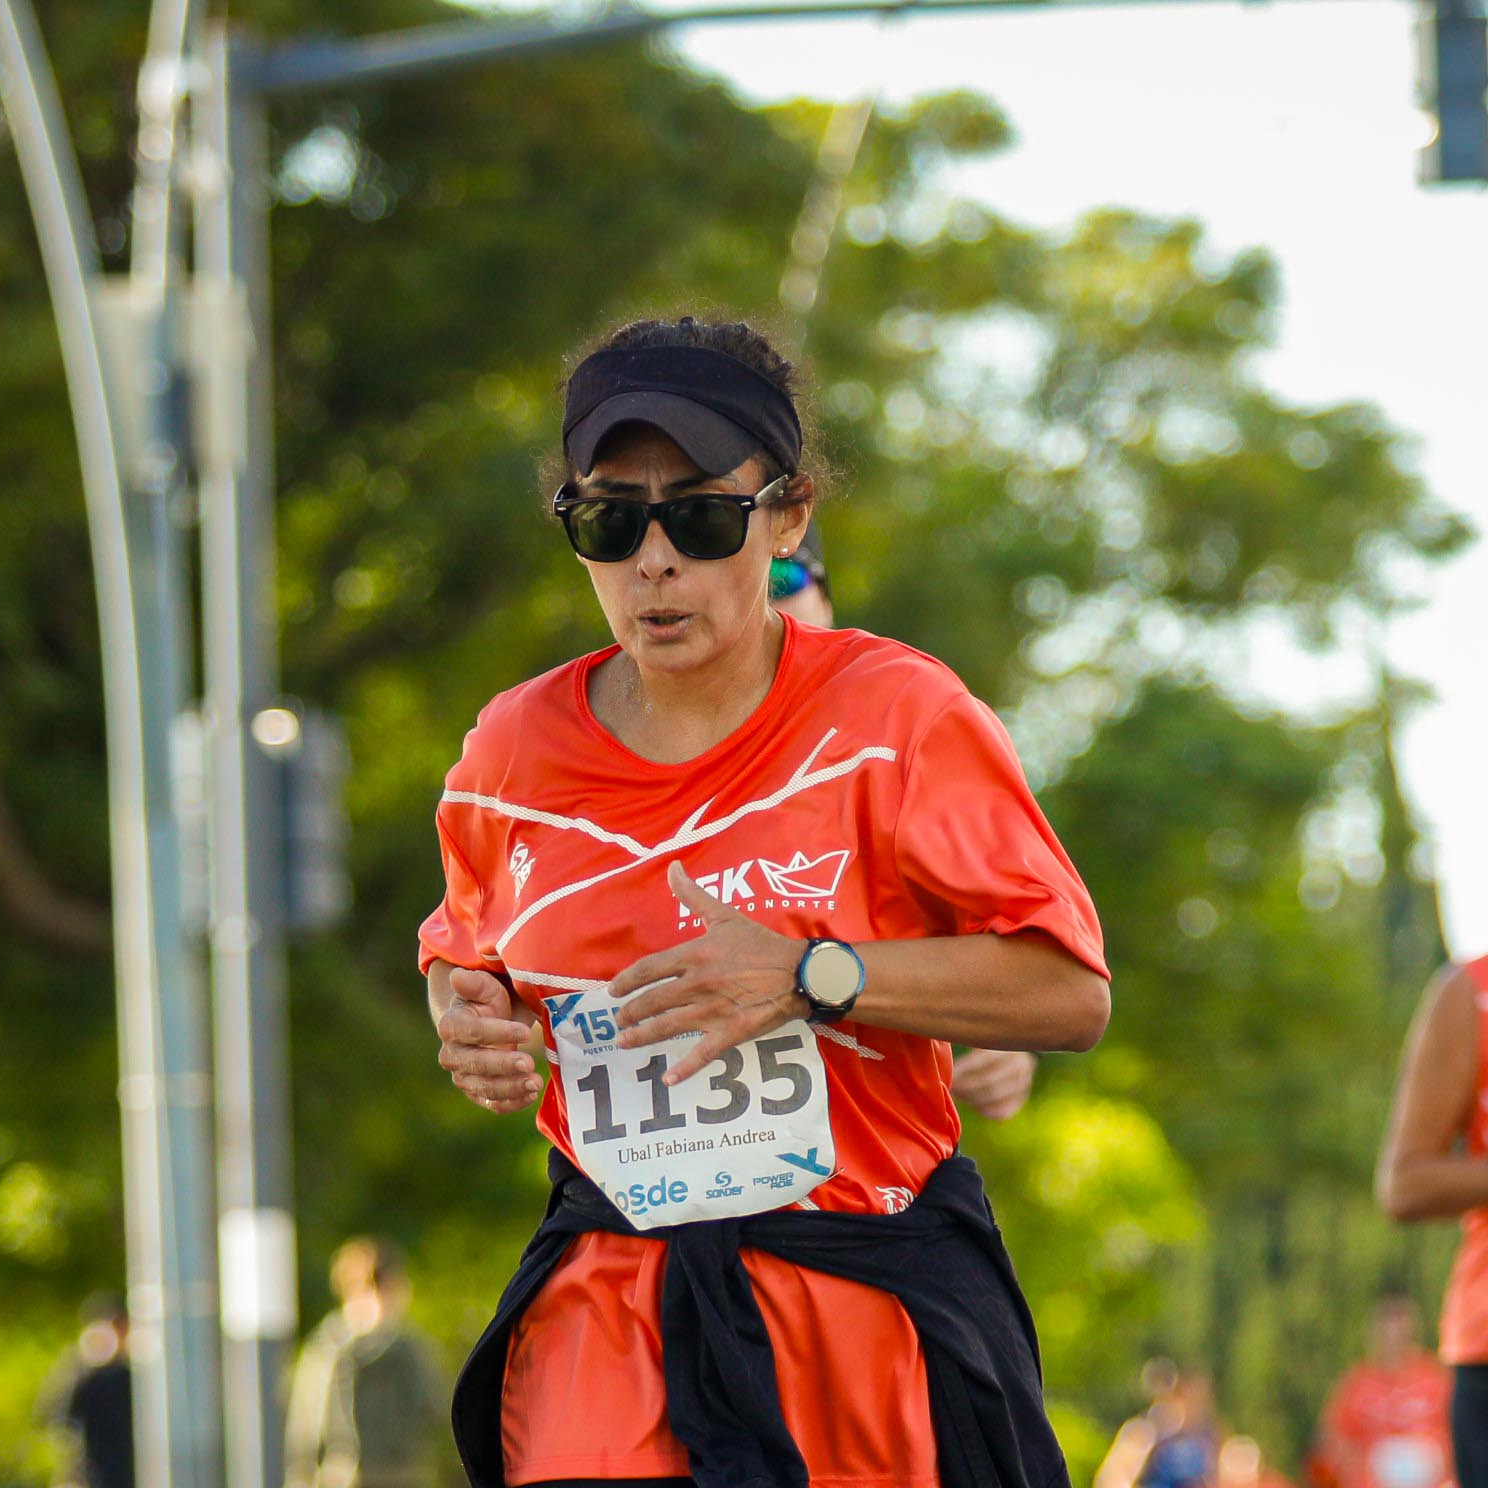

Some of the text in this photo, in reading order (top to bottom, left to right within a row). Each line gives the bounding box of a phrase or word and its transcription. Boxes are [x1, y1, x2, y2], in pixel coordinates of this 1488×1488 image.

[766, 898, 835, 910] NORTE
[583, 1045, 614, 1056] PUERTO
[577, 1034, 812, 1144] 1135
[618, 1129, 776, 1165] Ubal Fabiana Andrea
[753, 1172, 794, 1186] POWER
[615, 1176, 688, 1214] osde
